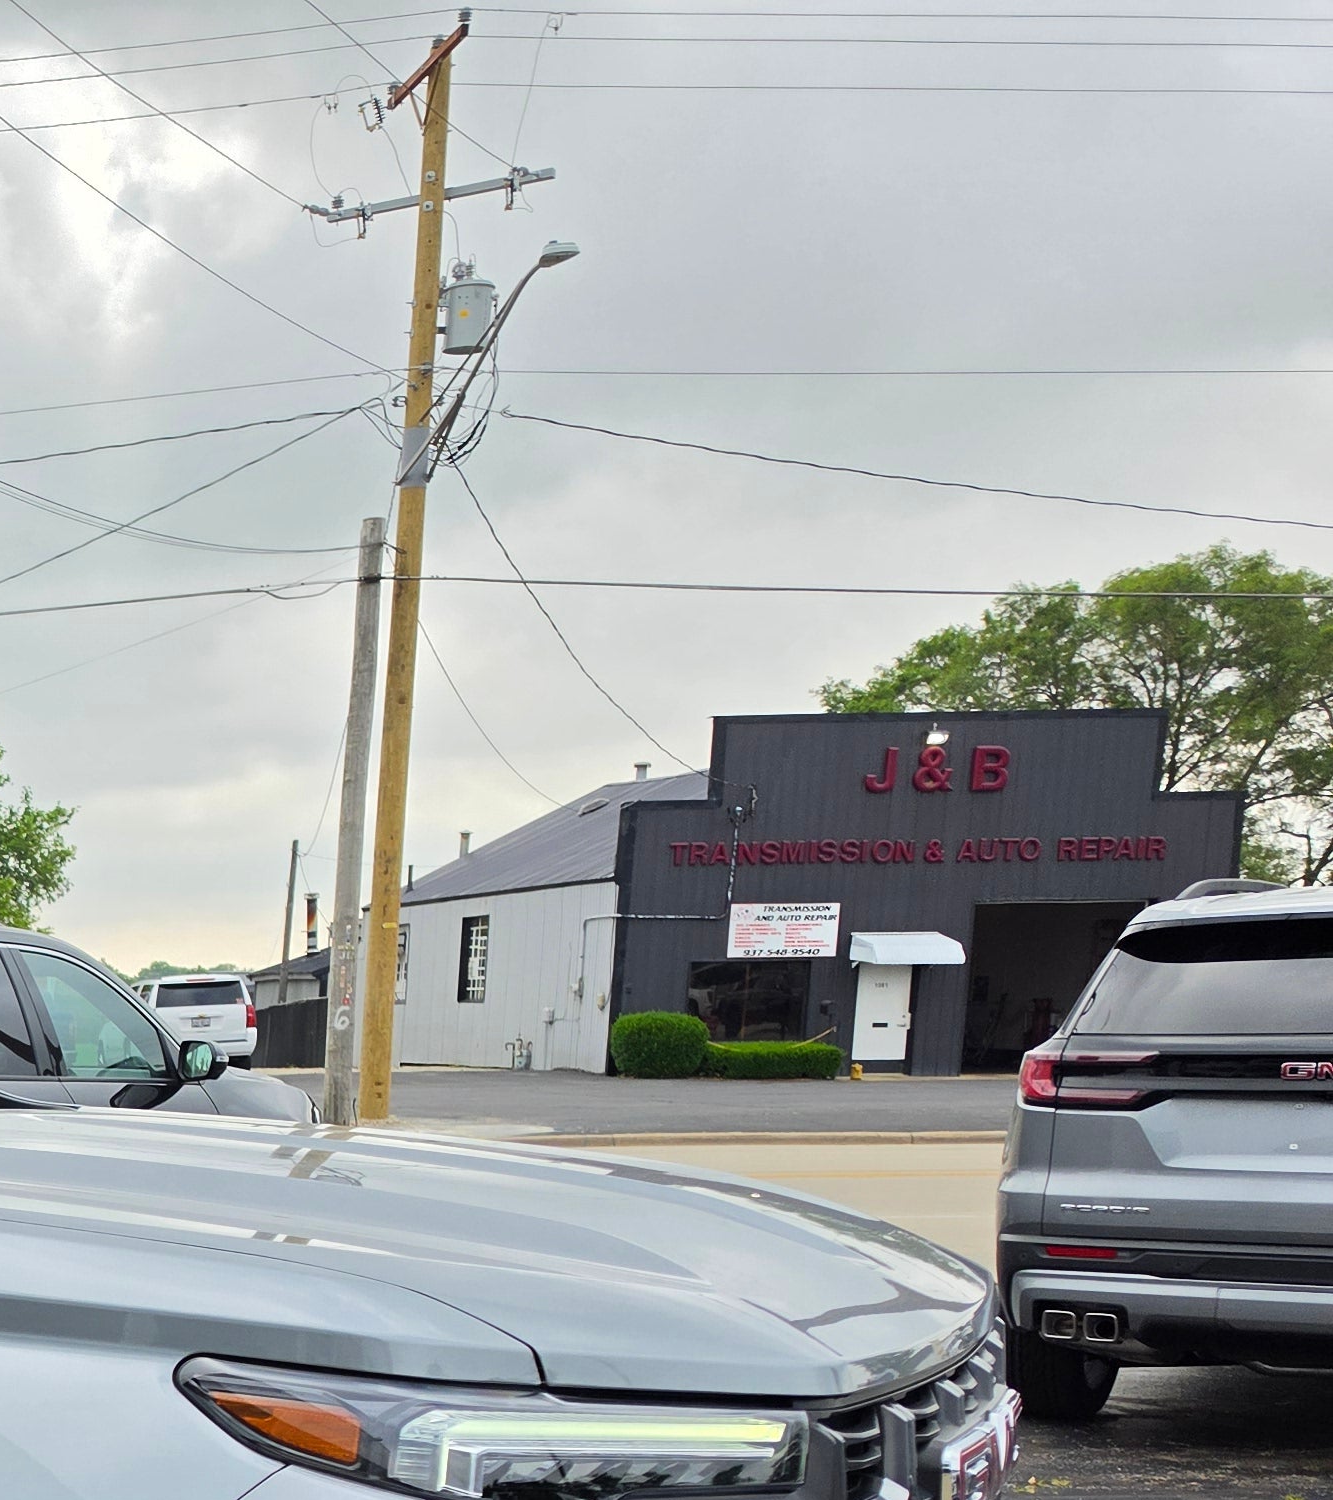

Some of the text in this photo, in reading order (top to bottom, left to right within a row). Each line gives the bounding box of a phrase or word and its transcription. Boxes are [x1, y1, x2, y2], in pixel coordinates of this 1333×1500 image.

[864, 745, 1012, 793] J & B
[669, 834, 1169, 867] TRANSMISSION & AUTO REPAIR
[754, 914, 775, 922] AND
[763, 905, 832, 913] TRANSMISSION
